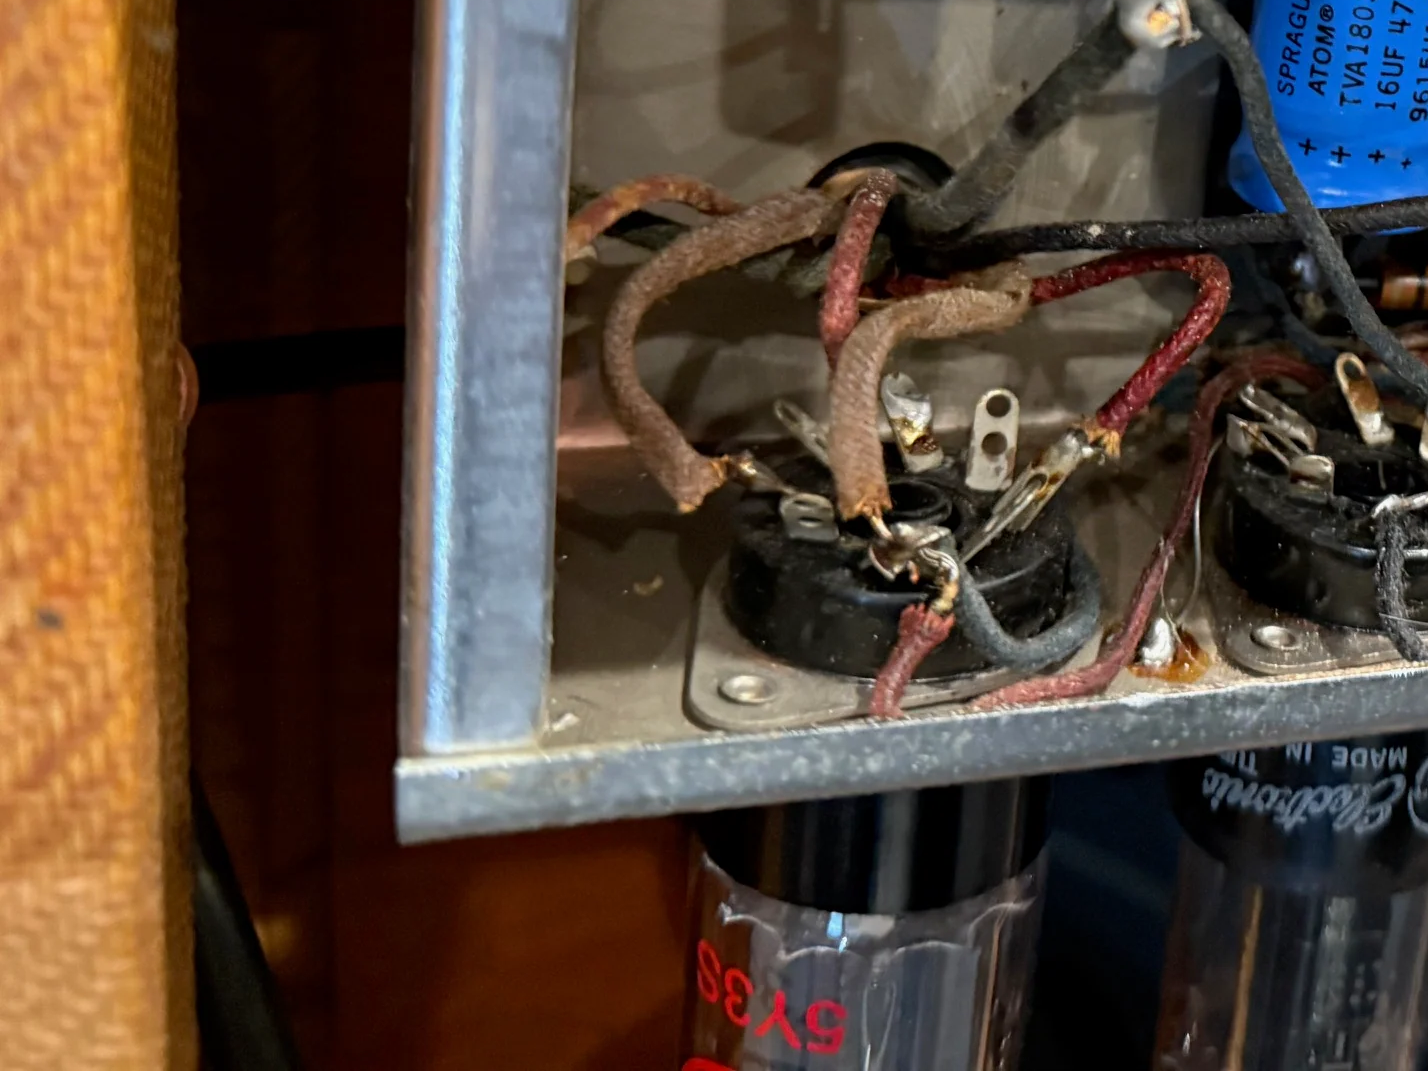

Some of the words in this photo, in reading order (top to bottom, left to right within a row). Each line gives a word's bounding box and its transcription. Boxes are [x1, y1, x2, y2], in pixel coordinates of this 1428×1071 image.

[1308, 4, 1335, 96] ATOM®
[1375, 46, 1404, 110] 16UF
[1286, 742, 1313, 765] IN
[1332, 745, 1408, 770] MADE
[1202, 768, 1406, 835] Electronic
